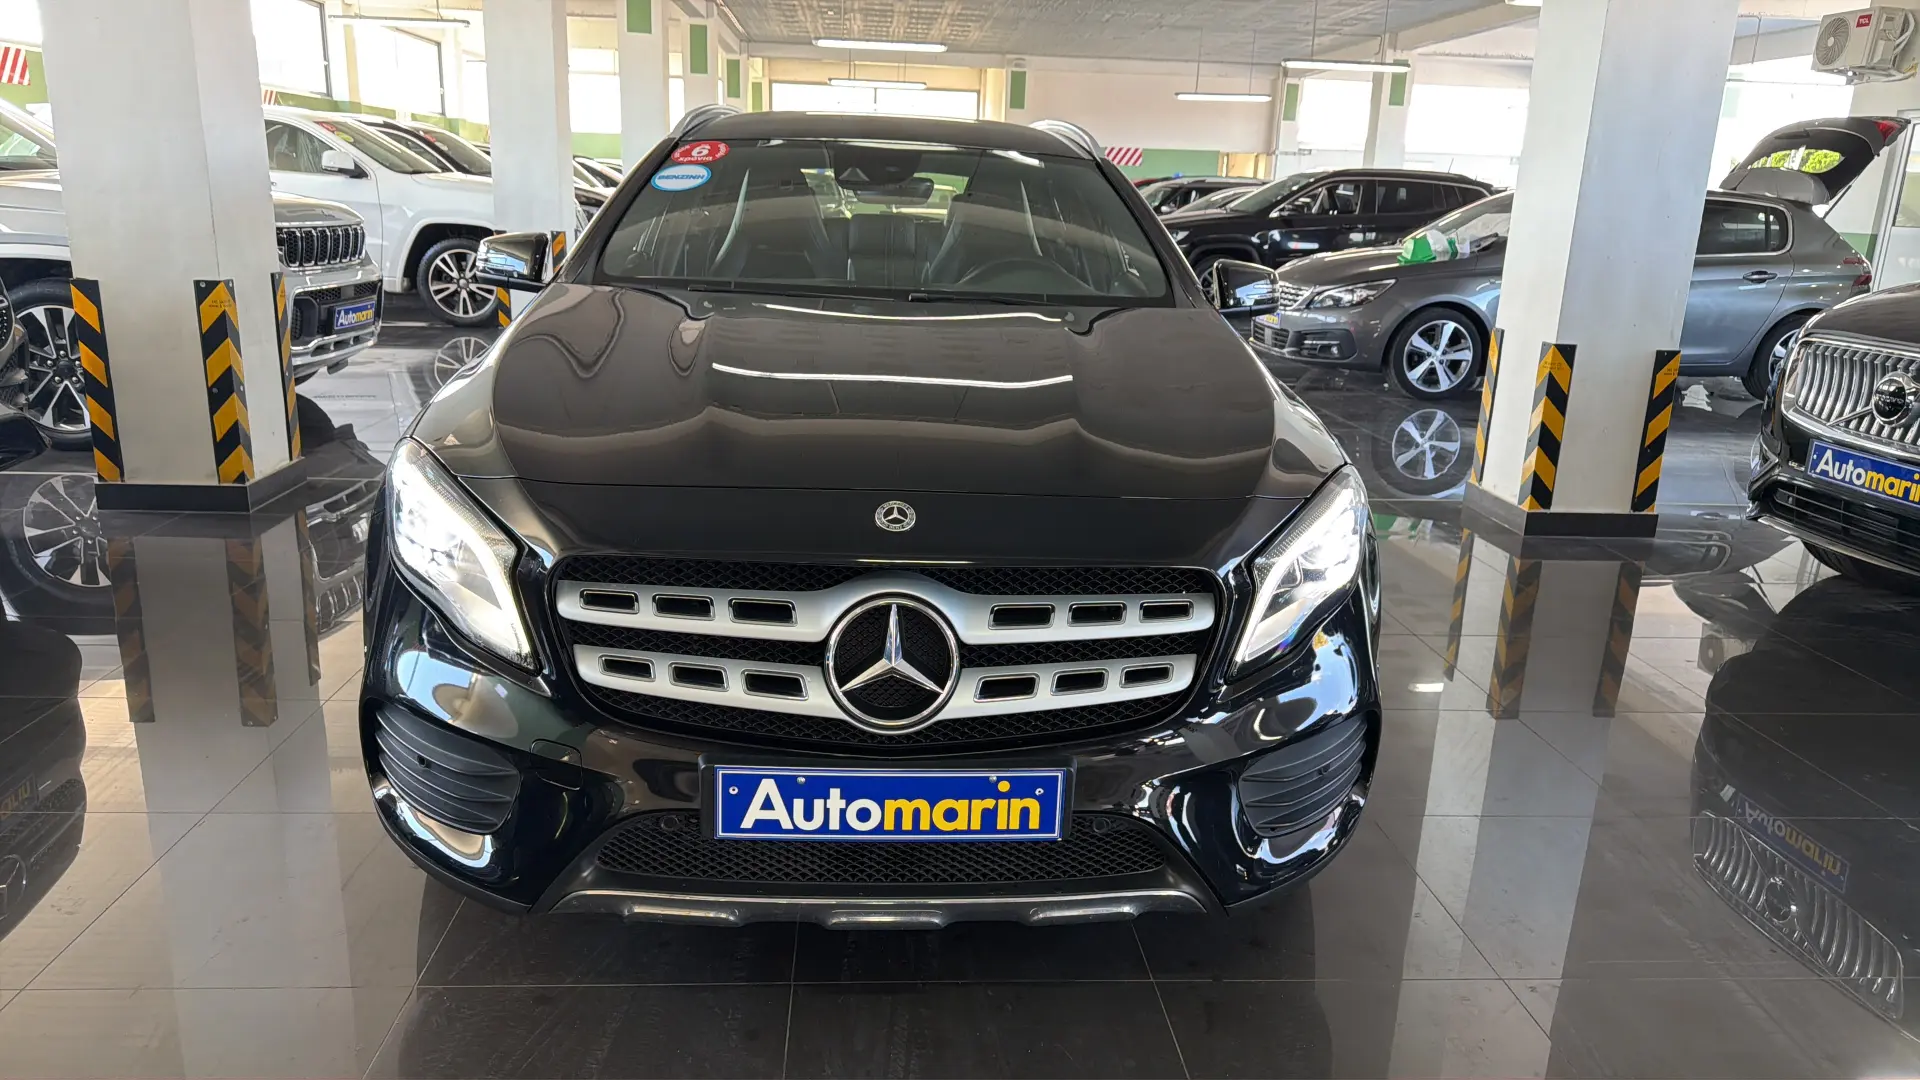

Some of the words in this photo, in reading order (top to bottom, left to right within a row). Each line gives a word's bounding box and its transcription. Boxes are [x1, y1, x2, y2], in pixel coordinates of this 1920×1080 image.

[691, 145, 711, 157] 6
[338, 308, 373, 327] Automarin
[740, 778, 1041, 832] Automarin
